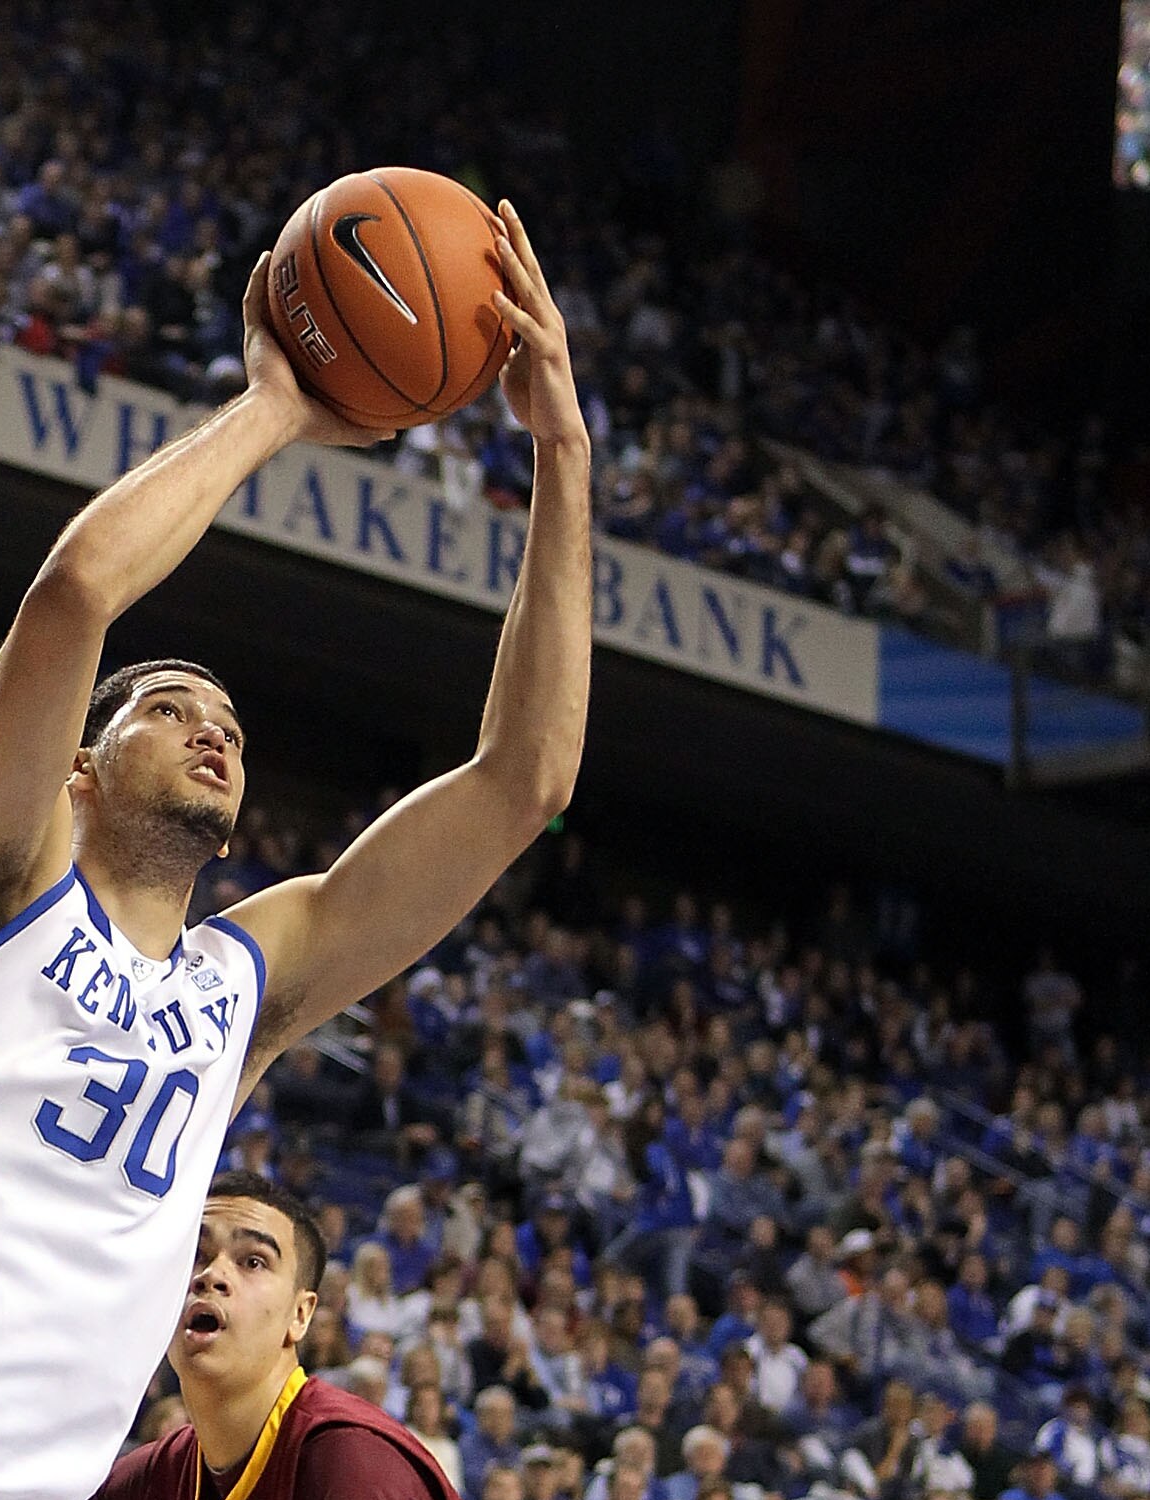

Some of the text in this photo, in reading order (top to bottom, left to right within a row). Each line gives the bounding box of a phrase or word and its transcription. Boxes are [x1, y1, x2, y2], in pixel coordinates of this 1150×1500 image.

[277, 251, 338, 370] ELITE
[593, 550, 810, 691] BANK
[32, 1046, 200, 1201] 30
